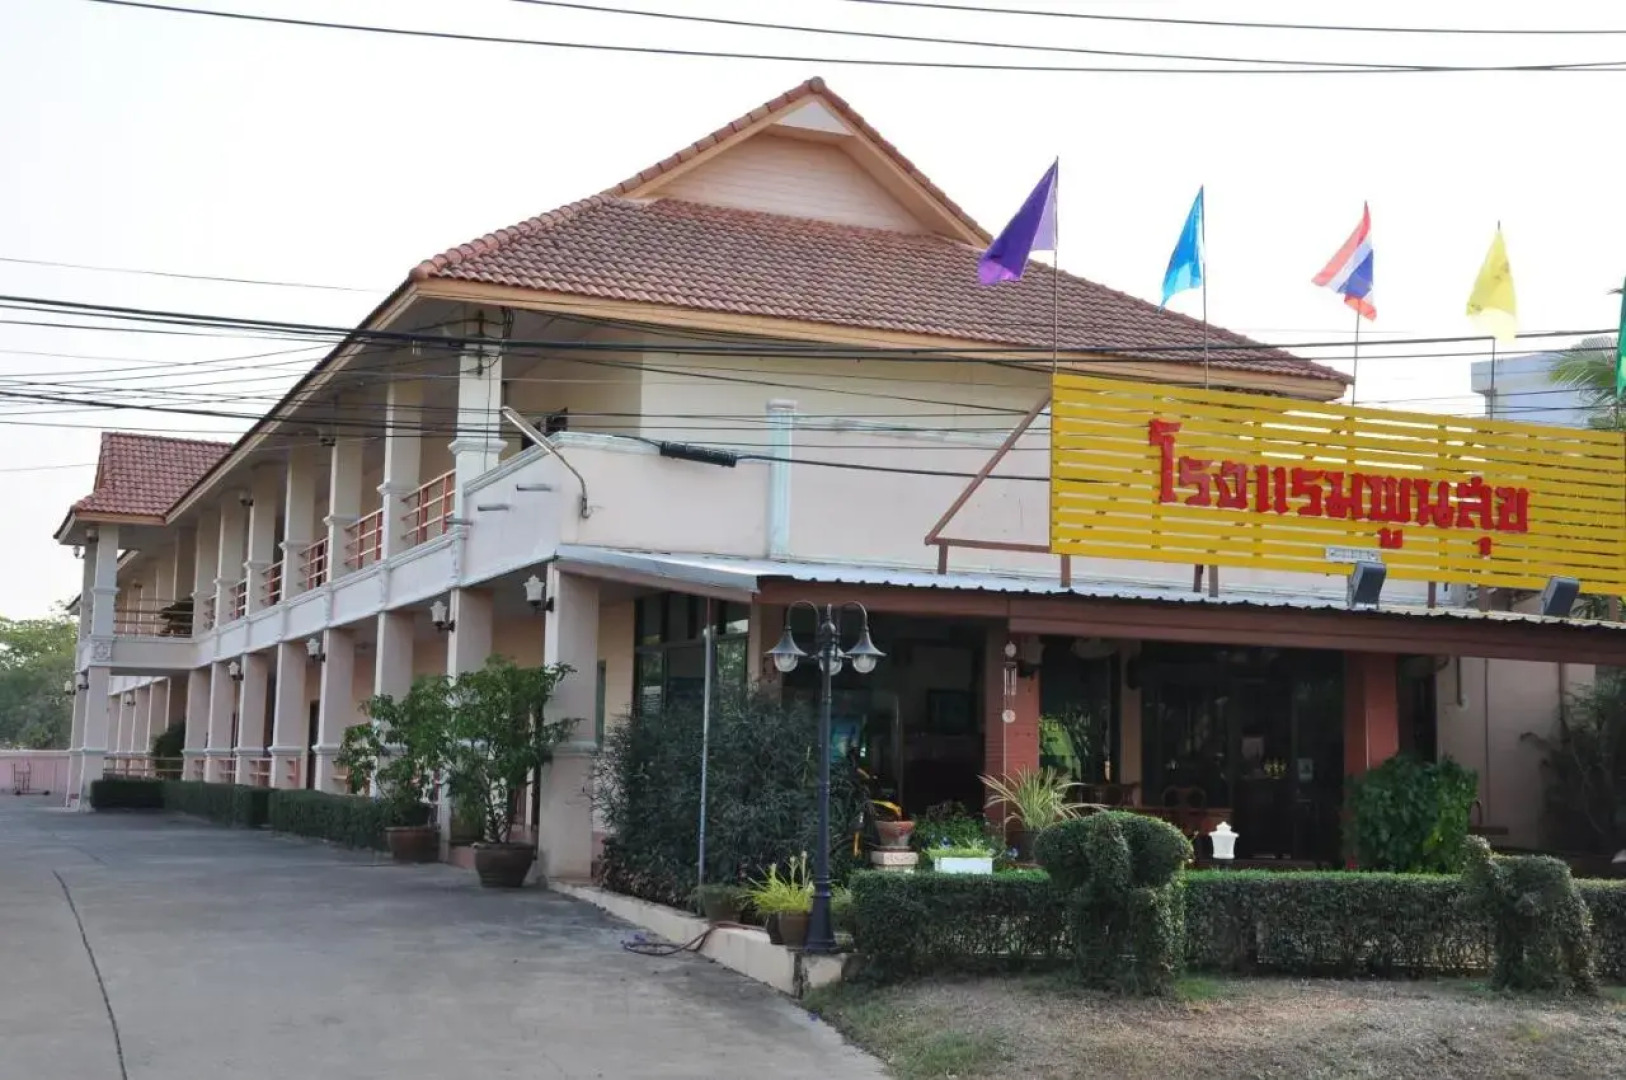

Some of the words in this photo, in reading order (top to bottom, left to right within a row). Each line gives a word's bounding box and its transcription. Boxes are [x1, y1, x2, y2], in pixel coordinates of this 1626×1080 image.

[1148, 419, 1528, 556] โรงแรมพูนสุข
